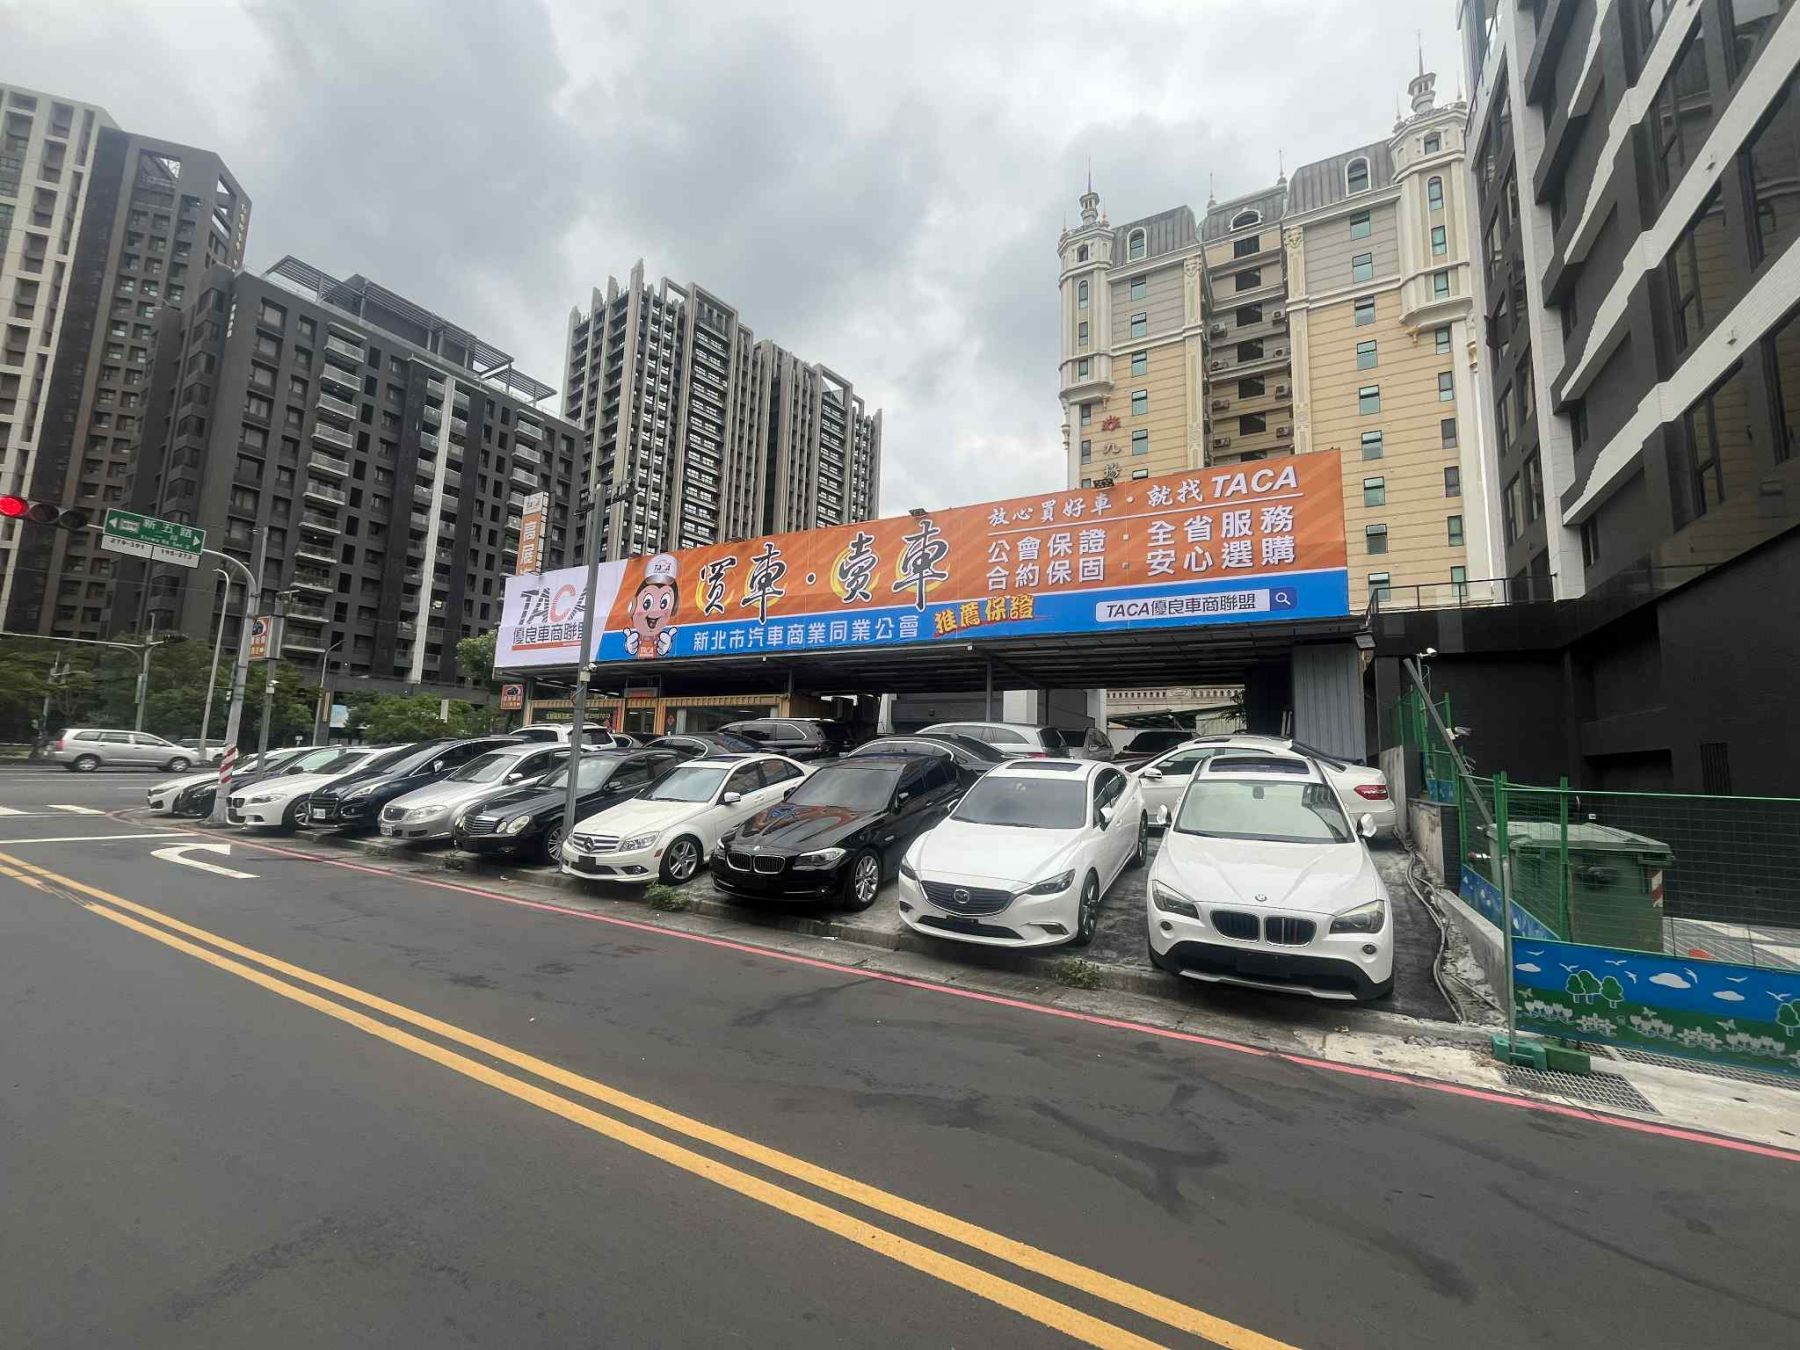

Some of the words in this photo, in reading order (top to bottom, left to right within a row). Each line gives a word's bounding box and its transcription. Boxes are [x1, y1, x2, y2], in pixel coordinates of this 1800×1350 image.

[693, 615, 919, 651] 新北市汽車商業同業公會
[934, 595, 1036, 634] 推薦保證
